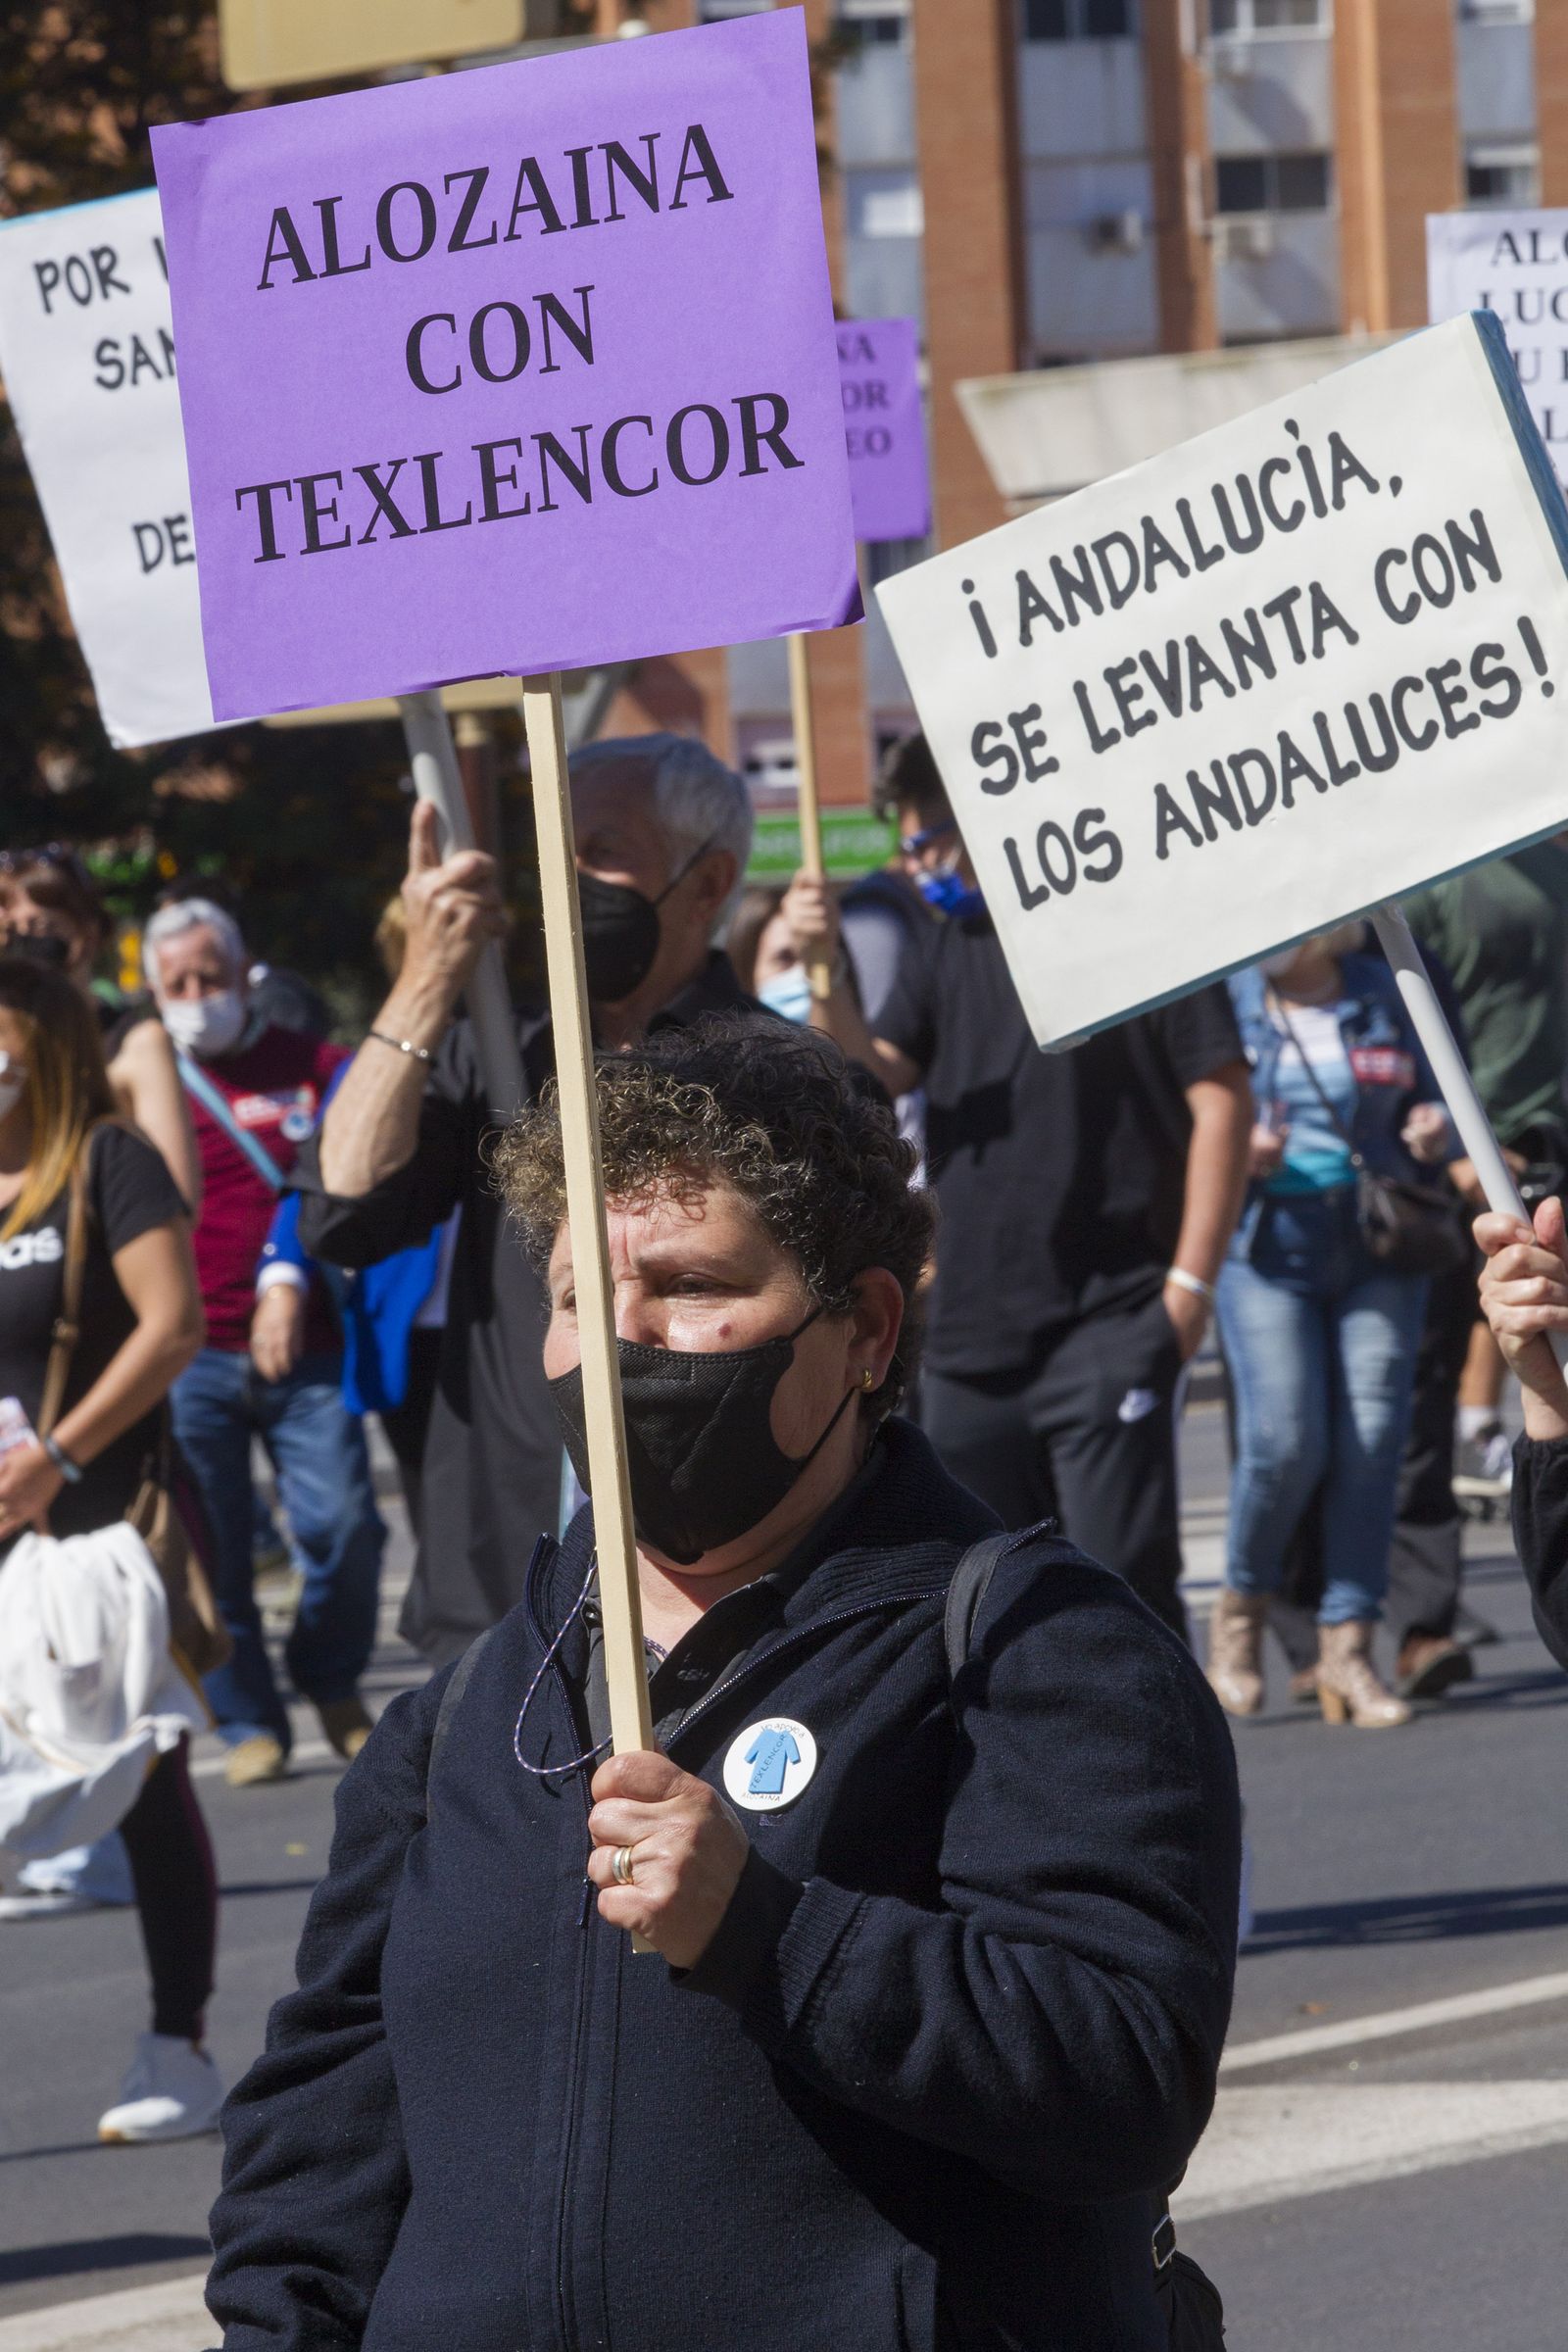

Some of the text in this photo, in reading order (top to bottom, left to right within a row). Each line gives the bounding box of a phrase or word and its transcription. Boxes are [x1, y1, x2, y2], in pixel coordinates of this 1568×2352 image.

[256, 123, 735, 291] ALOZAINA
[33, 244, 131, 315] POR
[405, 284, 595, 395] CON
[132, 513, 195, 574] DE
[234, 392, 806, 564] TEXLENCOR
[970, 508, 1502, 797] SE LEVANTA CON
[1003, 615, 1555, 911] LOS ANDALUCES!
[750, 1734, 786, 1788] TEXLENCOR
